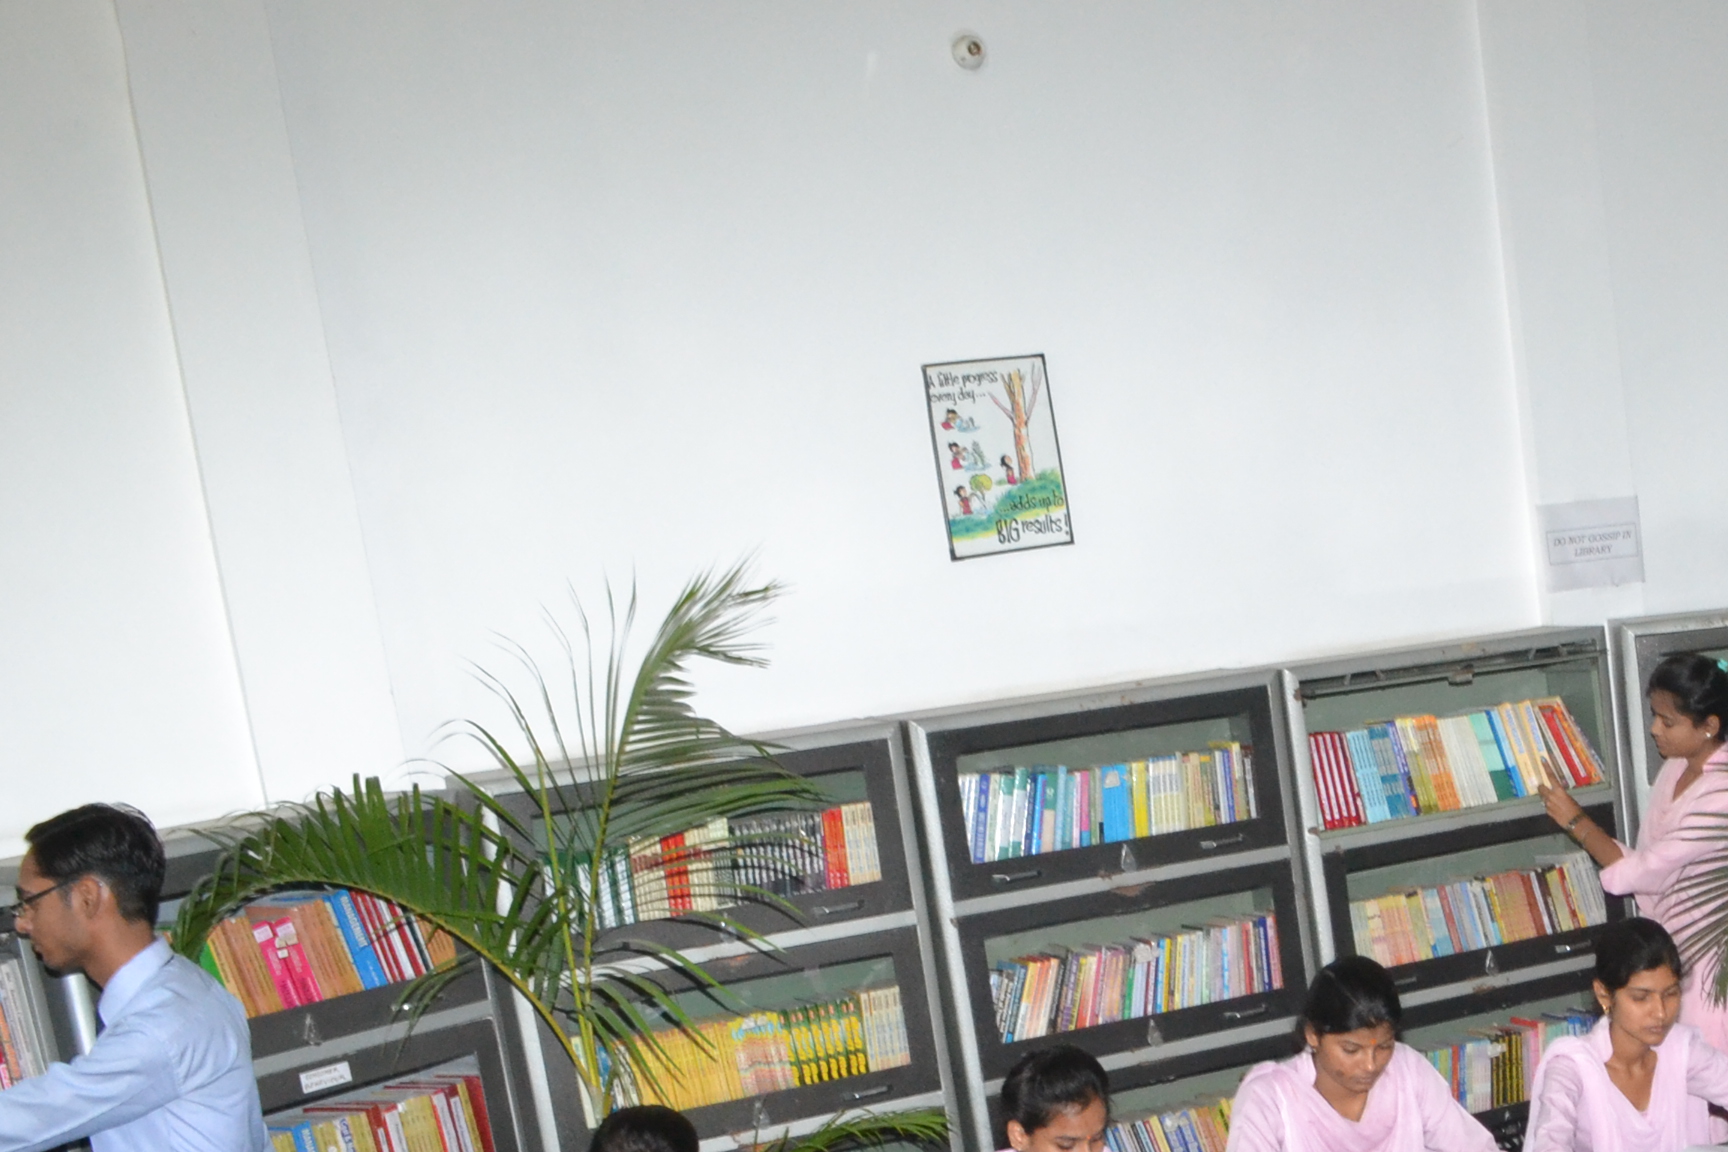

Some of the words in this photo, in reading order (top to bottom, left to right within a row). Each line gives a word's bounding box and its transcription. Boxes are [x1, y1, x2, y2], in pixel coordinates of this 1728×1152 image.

[937, 371, 960, 388] little
[961, 369, 999, 388] progress
[930, 392, 957, 406] every
[1038, 496, 1051, 512] up
[1052, 489, 1065, 508] to
[995, 517, 1021, 544] BIG
[1553, 536, 1567, 547] DO
[1567, 534, 1586, 546] NOT
[1588, 530, 1621, 543] GOSSIP
[1621, 529, 1632, 541] IN
[1574, 544, 1613, 557] LIBRARY
[340, 896, 369, 948] MANAGEMENT
